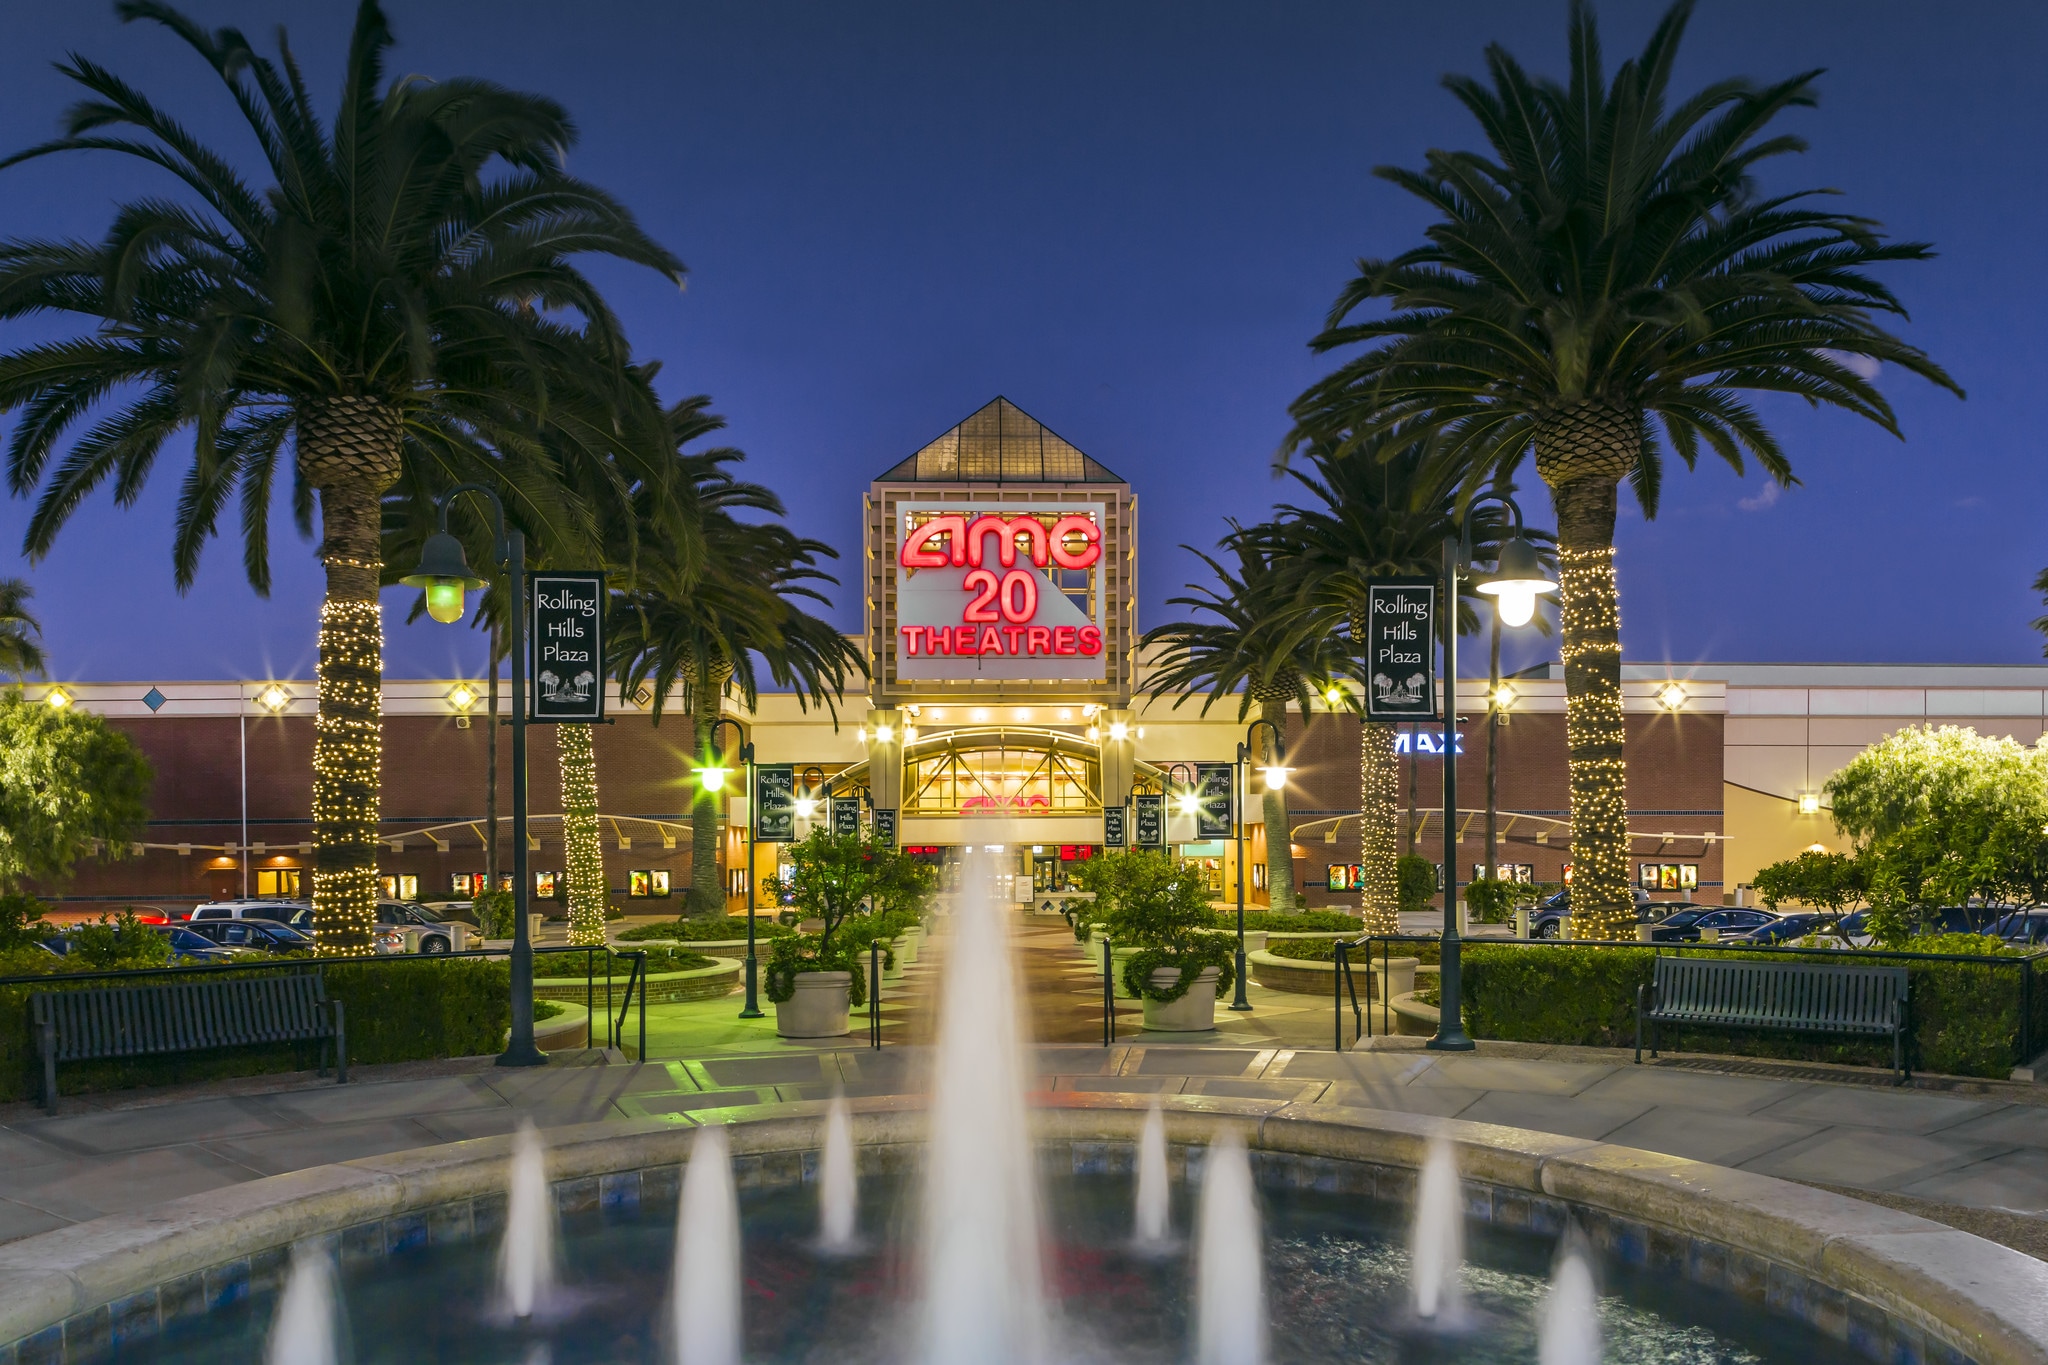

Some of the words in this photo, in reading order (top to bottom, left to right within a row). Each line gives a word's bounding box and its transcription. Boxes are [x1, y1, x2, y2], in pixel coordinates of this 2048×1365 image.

[538, 589, 596, 617] Rolling
[963, 569, 1038, 624] 20
[1374, 594, 1428, 620] Rolling
[548, 617, 584, 638] Hills
[1383, 621, 1417, 640] Hills
[901, 626, 1102, 656] THEATRES
[544, 642, 588, 661] Plaza
[1379, 644, 1421, 663] Plaza
[760, 773, 790, 787] Rolling
[1200, 773, 1229, 786] Rolling
[765, 787, 785, 798] Hills
[1206, 786, 1223, 796] Hills
[763, 800, 787, 811] Plaza
[836, 804, 856, 813] Rolling
[1139, 800, 1158, 810] Rolling
[1203, 799, 1226, 809] Plaza
[840, 813, 853, 821] Hills
[1140, 819, 1157, 827] Plaza
[838, 822, 855, 830] Plaza
